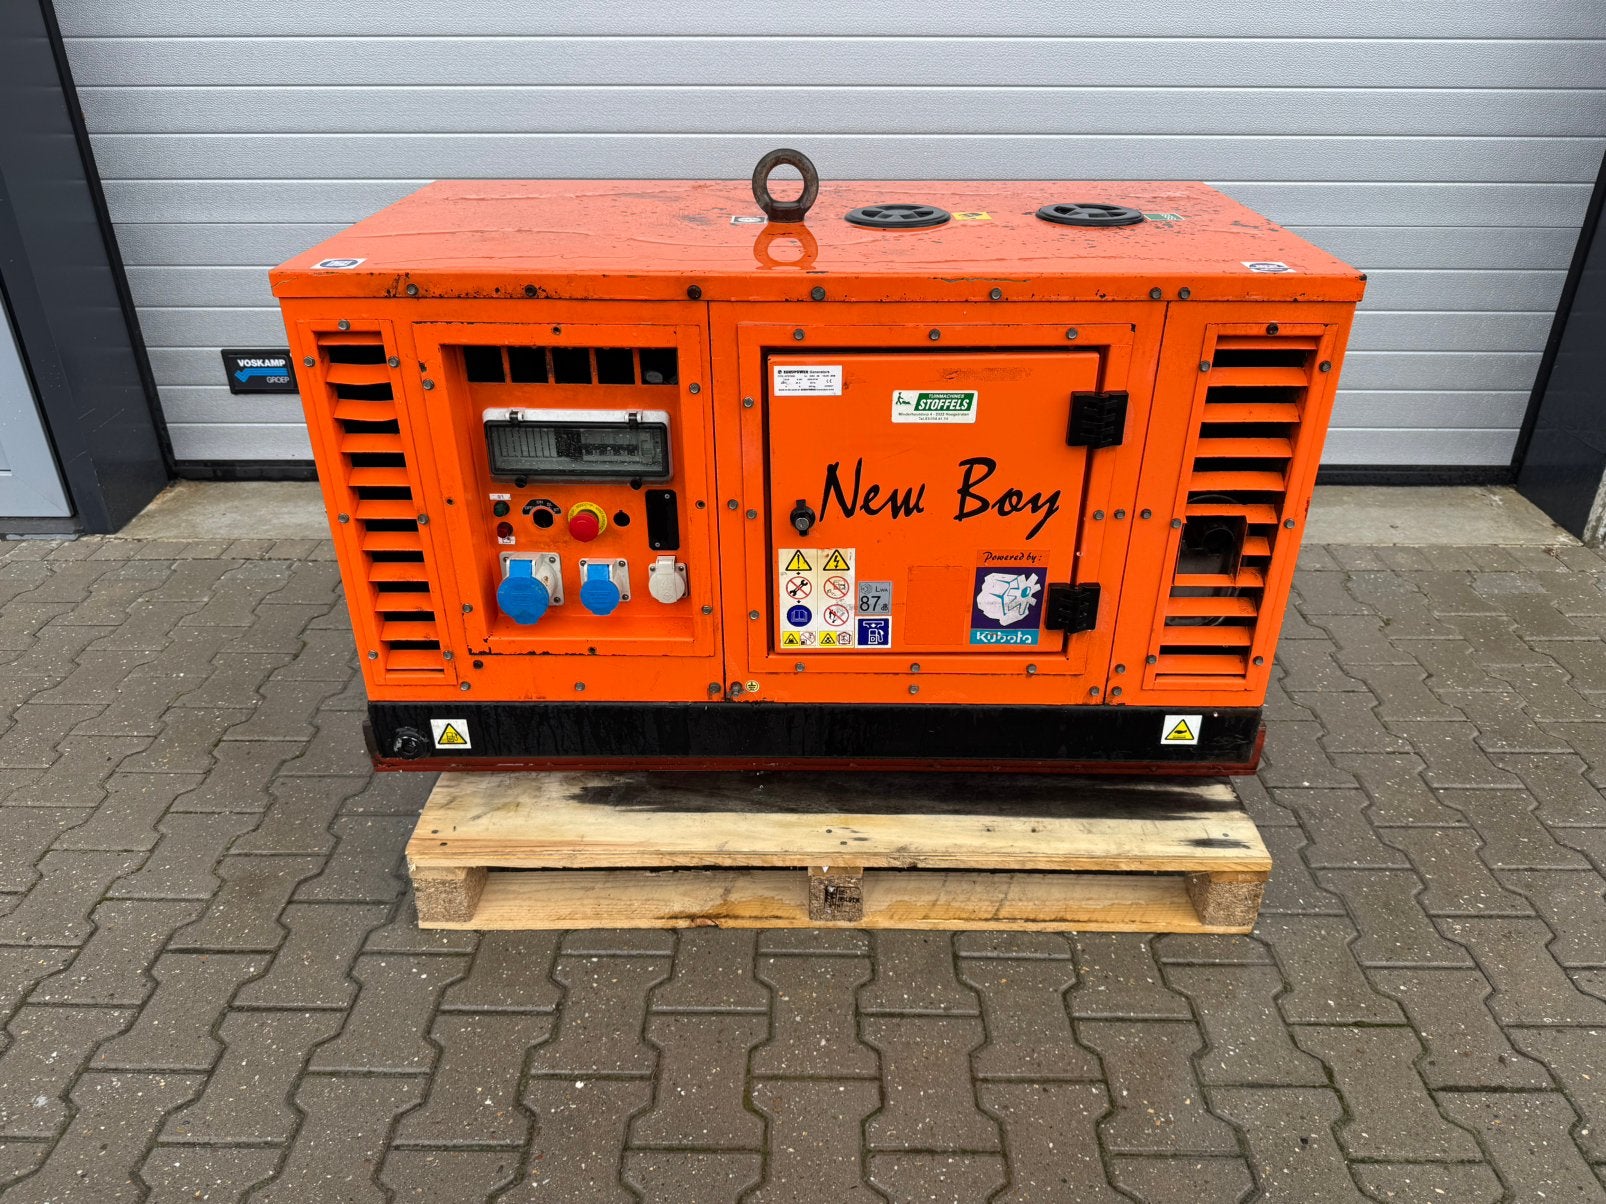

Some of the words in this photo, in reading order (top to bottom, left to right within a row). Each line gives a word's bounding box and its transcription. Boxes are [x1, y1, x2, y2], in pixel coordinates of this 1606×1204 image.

[237, 359, 286, 367] VOSKAMP
[918, 399, 969, 410] STOFFELS
[818, 457, 926, 523] New
[952, 456, 1062, 541] Boy
[982, 551, 1025, 562] Powered
[859, 595, 881, 612] 87
[976, 631, 1032, 644] Kubota
